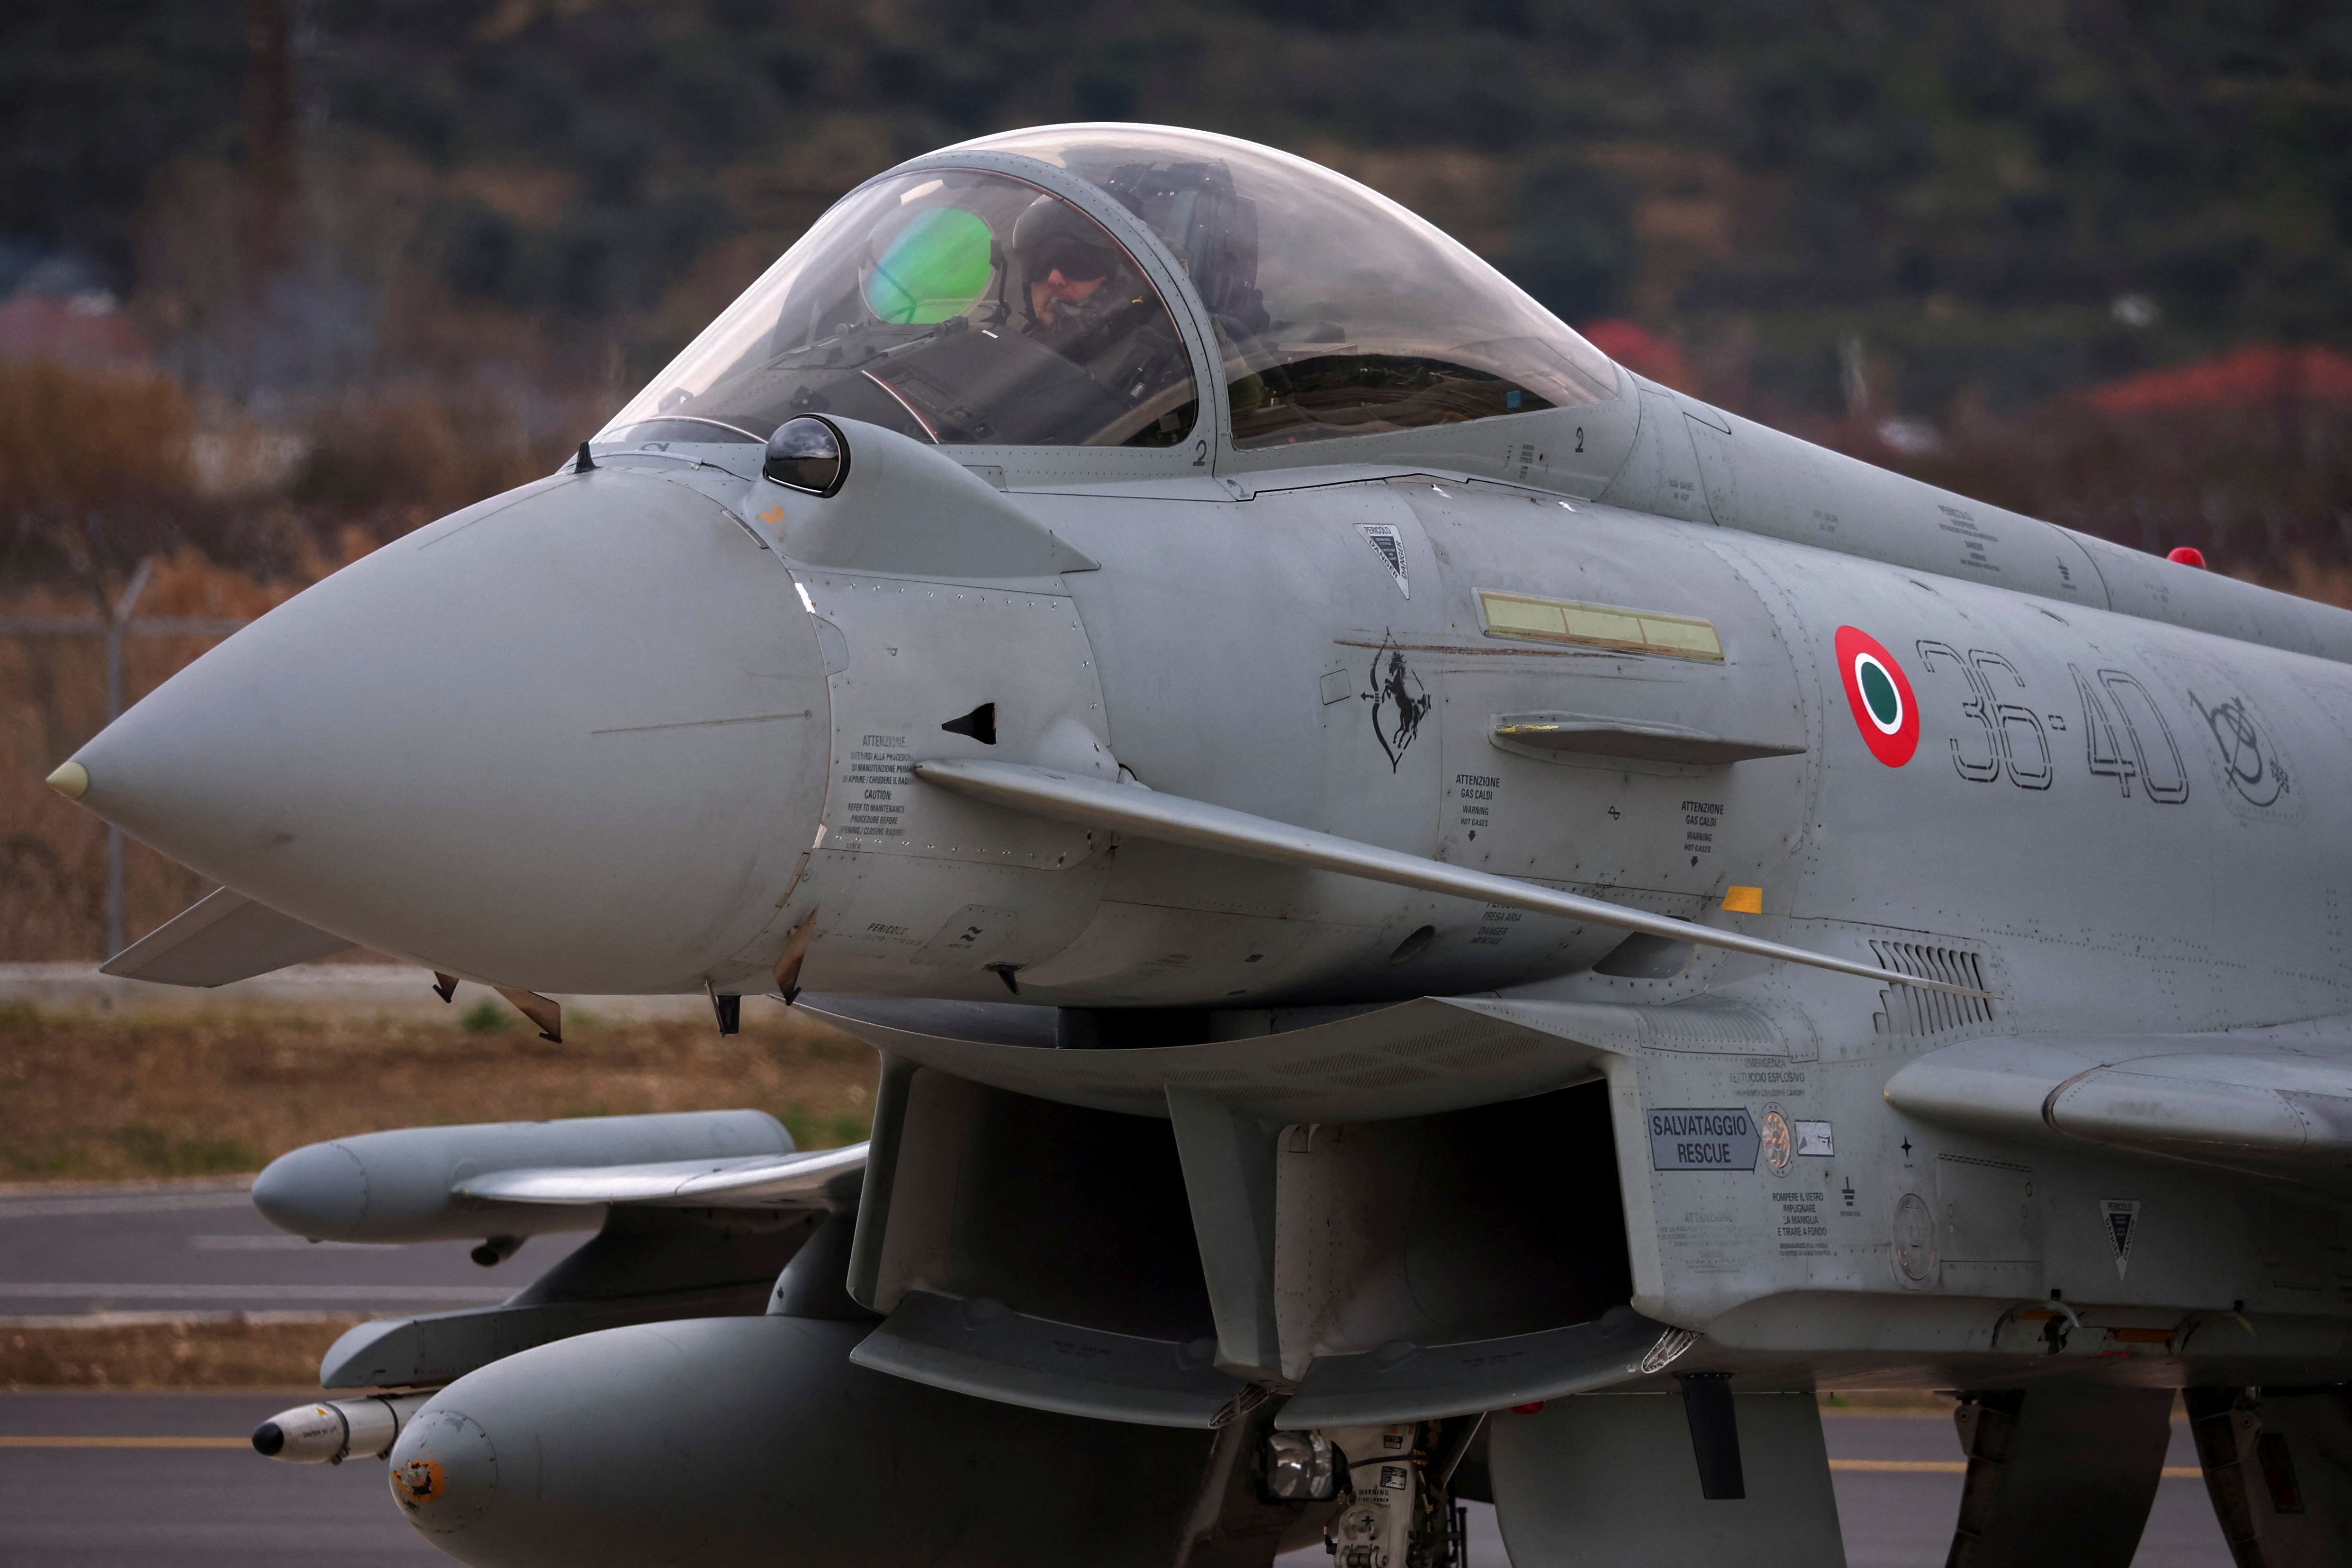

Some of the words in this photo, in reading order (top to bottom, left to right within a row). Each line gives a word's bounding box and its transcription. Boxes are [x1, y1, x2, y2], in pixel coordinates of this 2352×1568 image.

[1575, 426, 1583, 453] 2
[1192, 439, 1207, 467] 2
[1363, 526, 1391, 534] PERICOLO
[1369, 539, 1398, 579] DANGER
[1396, 540, 1407, 579] DANGER
[1916, 640, 2189, 804] 36-40
[874, 752, 885, 761] ALLA
[851, 763, 857, 771] DI
[858, 763, 895, 773] MANUTENZIONE
[896, 765, 912, 773] PRIMA
[842, 775, 847, 783] DI
[848, 775, 865, 784] APRIRE
[866, 775, 869, 784] /
[869, 776, 892, 784] CHIUDERE
[1456, 774, 1500, 788] ATTENZIONE
[865, 789, 892, 800] CAUTION:
[1460, 788, 1474, 799] GAS
[1475, 790, 1493, 801] CALDI
[847, 803, 863, 811] REFER
[863, 803, 869, 811] TO
[870, 804, 905, 813] MAINTENANCE
[1462, 805, 1489, 816] WARNING
[1681, 801, 1724, 815] ATTENZIONE
[851, 815, 879, 824] PROCEDURE
[880, 816, 899, 825] BEFORE
[1471, 819, 1488, 827] GASES
[1685, 815, 1698, 825] GAS
[1699, 816, 1717, 827] CALDI
[840, 826, 860, 835] PENING
[864, 827, 884, 836] CLOSING
[1687, 831, 1712, 842] WARNING
[1694, 845, 1711, 853] GASES
[1481, 911, 1505, 921] PRESA
[1504, 913, 1522, 922] ARIA
[866, 922, 909, 935] PERICOLO
[1478, 926, 1509, 936] DANGER
[1744, 1057, 1786, 1068] EMERGENZA
[1767, 1072, 1805, 1083] ESPLOSIVO
[1652, 1115, 1747, 1135] SALVATAGGIO
[1677, 1143, 1731, 1163] RESCUE
[1772, 1192, 1798, 1201] ROMPERE
[1799, 1192, 1805, 1201] IL
[1805, 1192, 1824, 1201] VETRO
[1783, 1204, 1816, 1213] IMPUGNARE
[2108, 1202, 2132, 1211] PERICOLO
[1685, 1212, 1733, 1223] ATTENZIONE
[1791, 1215, 1819, 1225] MANIGLIA
[1777, 1227, 1782, 1236] E
[1782, 1227, 1801, 1236] TIRARE
[1802, 1227, 1807, 1236] A
[1808, 1227, 1827, 1236] FONDO
[2105, 1217, 2120, 1261] DANGER
[2123, 1219, 2136, 1261] DANGER
